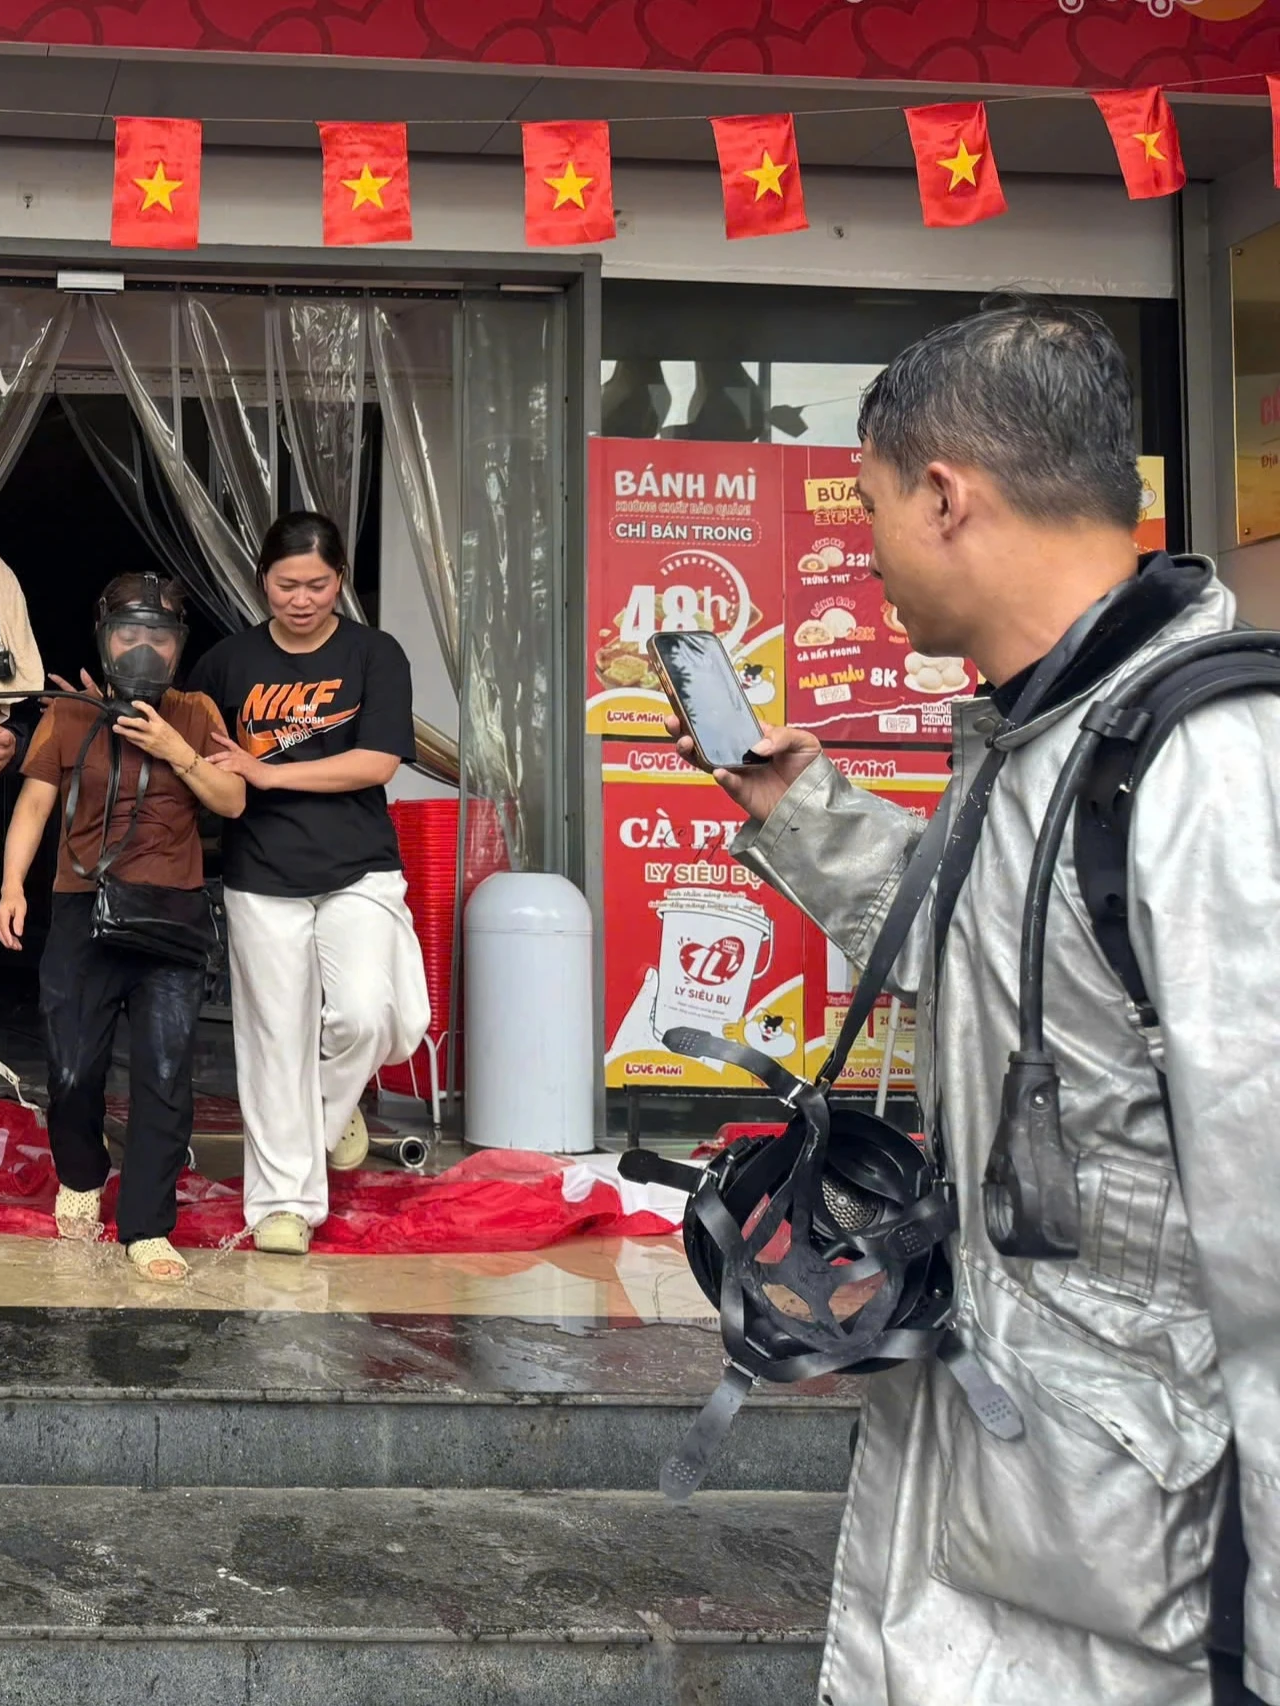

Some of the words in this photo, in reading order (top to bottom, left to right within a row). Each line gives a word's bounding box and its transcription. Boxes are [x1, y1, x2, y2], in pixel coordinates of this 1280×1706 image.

[614, 463, 706, 499] BÁNH
[714, 467, 757, 501] MÌ
[817, 481, 860, 502] BỮA
[616, 520, 646, 538] CHỈ
[651, 521, 687, 539] BÁN
[691, 525, 753, 541] TRONG
[801, 573, 829, 586] TRỨNG
[831, 573, 851, 585] THỊT
[870, 667, 898, 688] 8K
[606, 710, 635, 722] LOVE
[627, 749, 679, 772] LOVE
[619, 807, 680, 849] CÀ
[690, 820, 745, 850] PH
[645, 862, 671, 883] LY
[674, 859, 726, 884] SIÊU
[674, 986, 686, 996] LY
[688, 988, 714, 1003] SIÊU
[625, 1062, 653, 1075] LOVE
